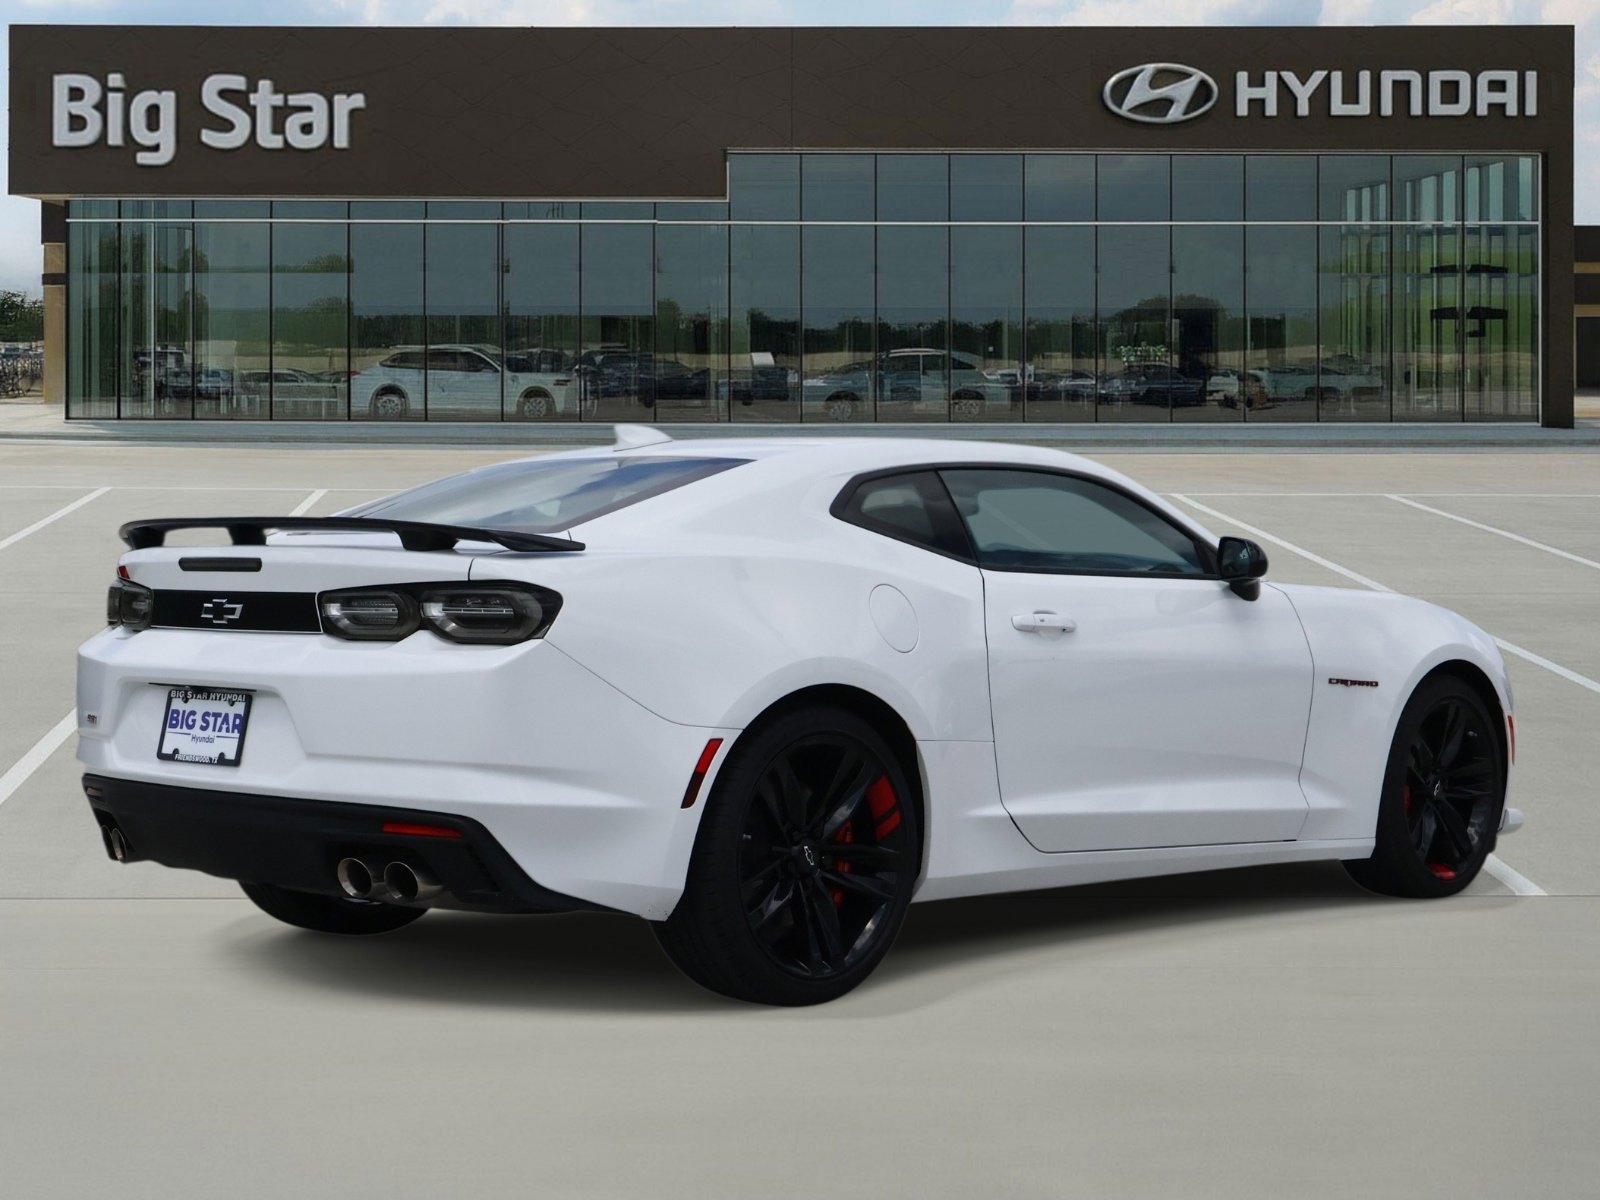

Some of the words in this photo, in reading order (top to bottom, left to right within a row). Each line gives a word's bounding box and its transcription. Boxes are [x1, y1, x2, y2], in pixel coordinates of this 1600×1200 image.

[1236, 70, 1537, 116] HYUNDAI
[53, 73, 176, 165] Big
[201, 73, 366, 149] Star
[171, 690, 184, 698] BIG
[209, 693, 246, 702] HYUNDAI
[168, 709, 197, 730] BIG
[199, 711, 243, 734] STAR
[191, 734, 216, 744] Hyundai
